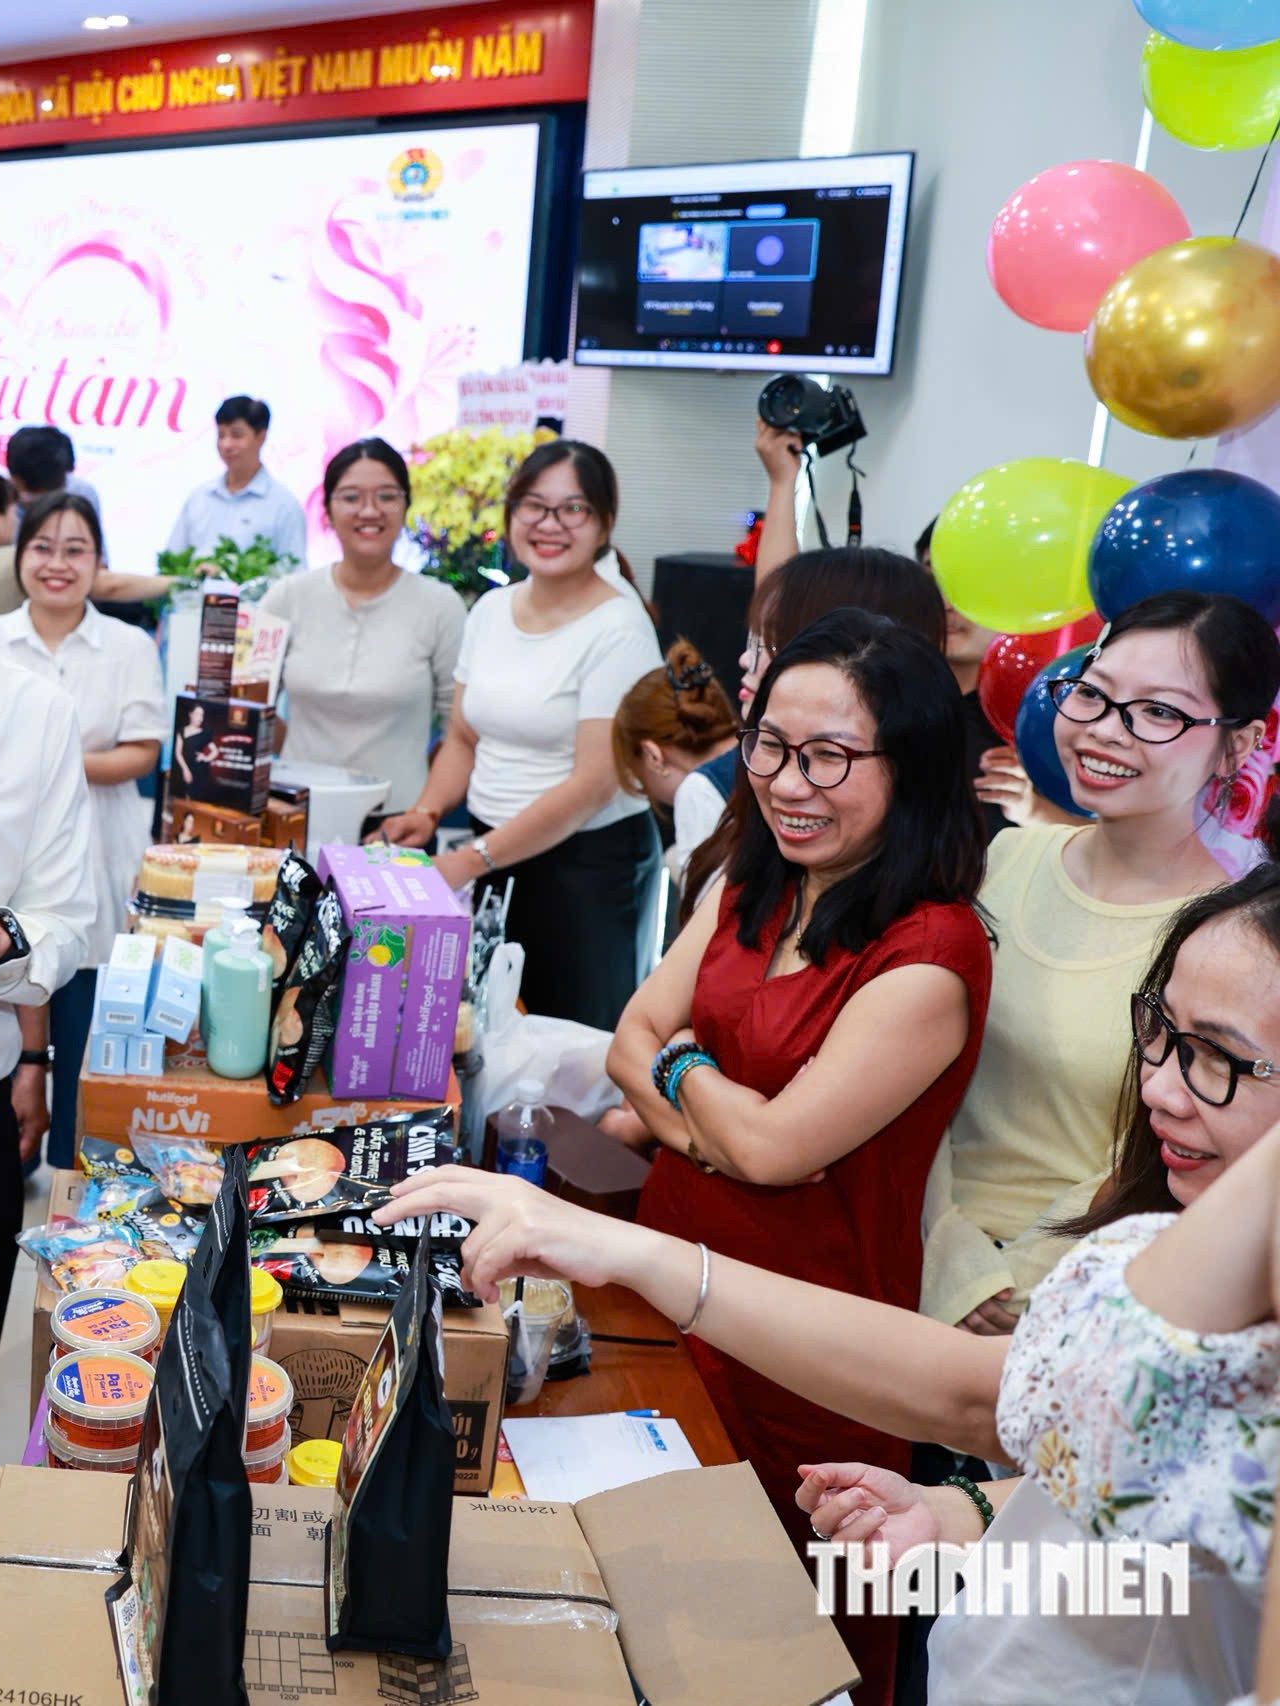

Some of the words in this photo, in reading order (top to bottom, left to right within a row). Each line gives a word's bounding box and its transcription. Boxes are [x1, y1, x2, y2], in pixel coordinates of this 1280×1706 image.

[117, 58, 166, 112] CHỦ
[248, 47, 306, 107] VIỆT
[311, 48, 373, 93] NAM
[378, 27, 464, 87] MUÔN
[471, 23, 543, 78] NĂM
[417, 984, 437, 1033] Nutifood
[146, 1090, 198, 1107] Nutifood
[406, 1125, 437, 1177] CHIN-S
[470, 1502, 557, 1515] 124106HK
[334, 1660, 355, 1669] 1000
[280, 1692, 300, 1701] 1200
